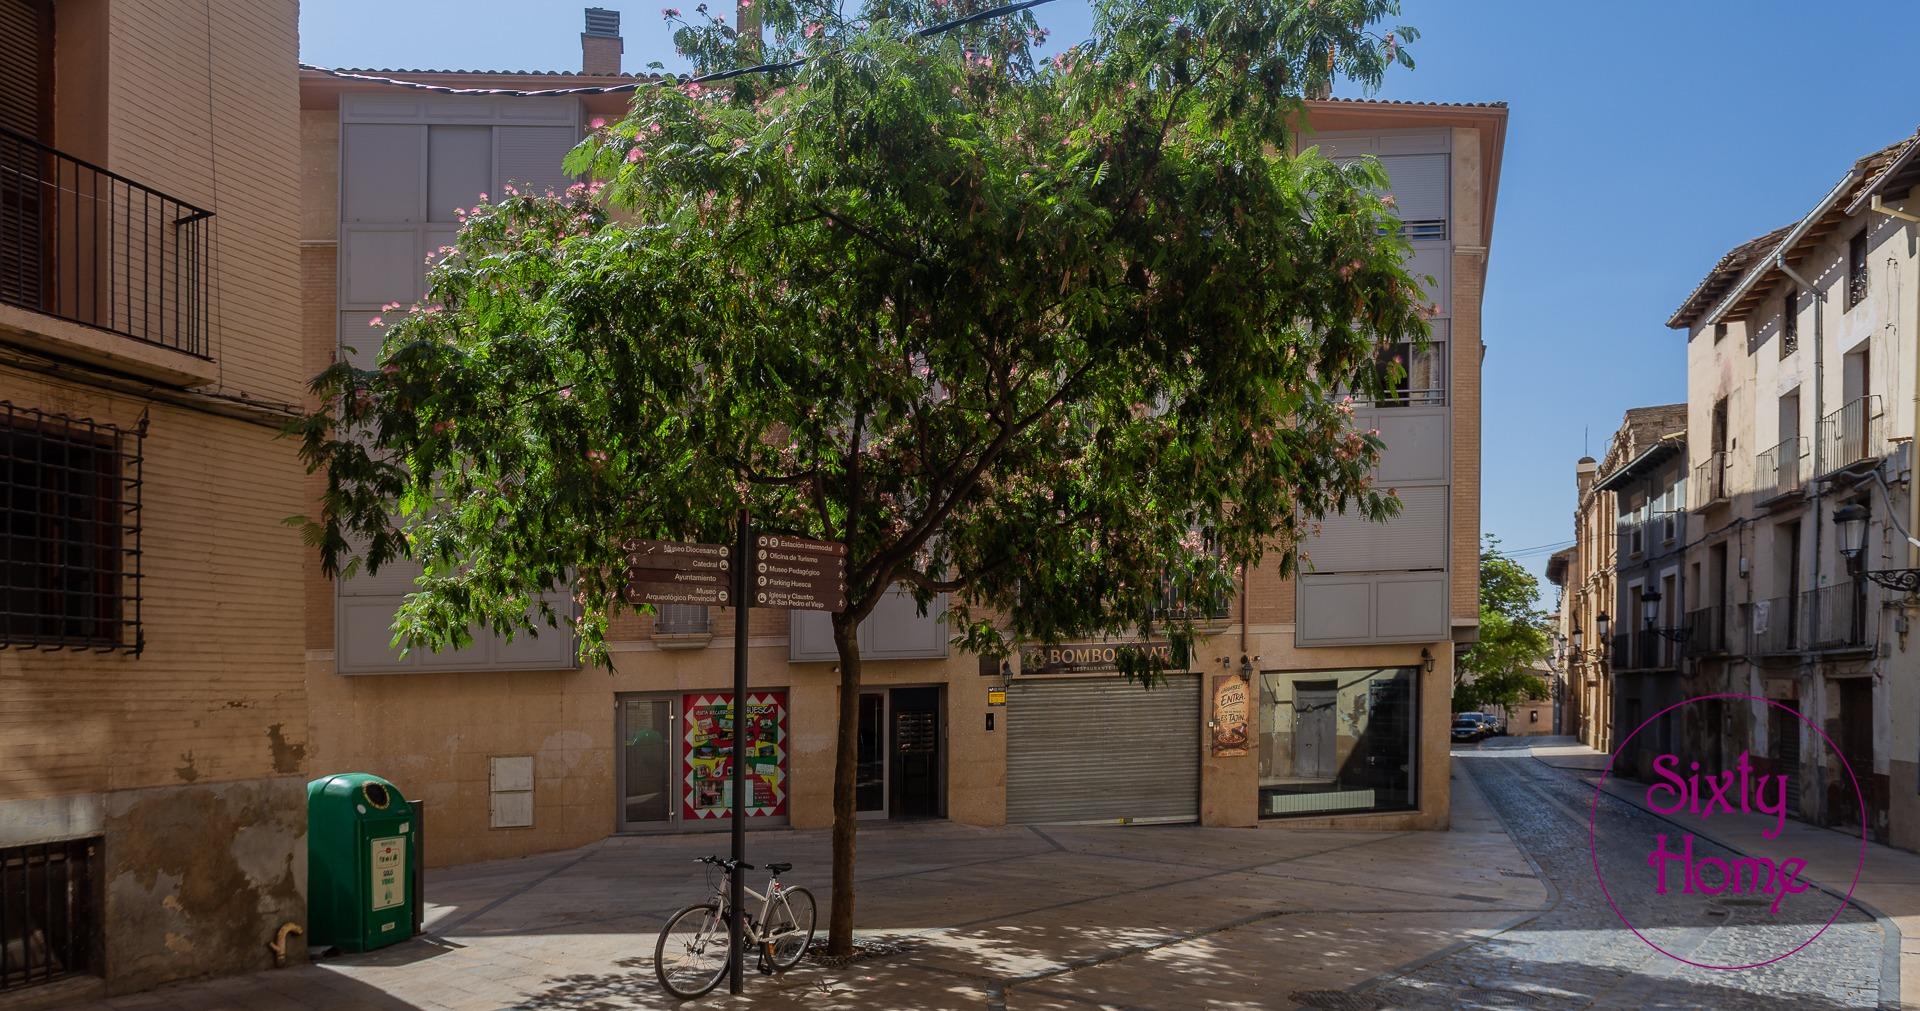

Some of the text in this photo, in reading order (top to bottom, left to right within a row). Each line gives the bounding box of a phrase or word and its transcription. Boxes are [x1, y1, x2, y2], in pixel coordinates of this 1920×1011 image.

[663, 544, 718, 554] Museo Diocesano
[780, 540, 833, 552] Estación Intermodal
[769, 552, 789, 560] Oficina
[797, 555, 819, 563] Turismo
[692, 560, 718, 568] Catedral
[769, 565, 821, 576] Museo Pedagógico
[674, 573, 717, 582] Ayuntamiento
[769, 578, 812, 588] Parking Huesca
[696, 587, 717, 595] Museo
[645, 593, 717, 602] Arqueológico Provincial
[769, 592, 787, 600] Iglesia
[788, 599, 805, 607] Pedro
[1050, 647, 1168, 664] BOMBOAT
